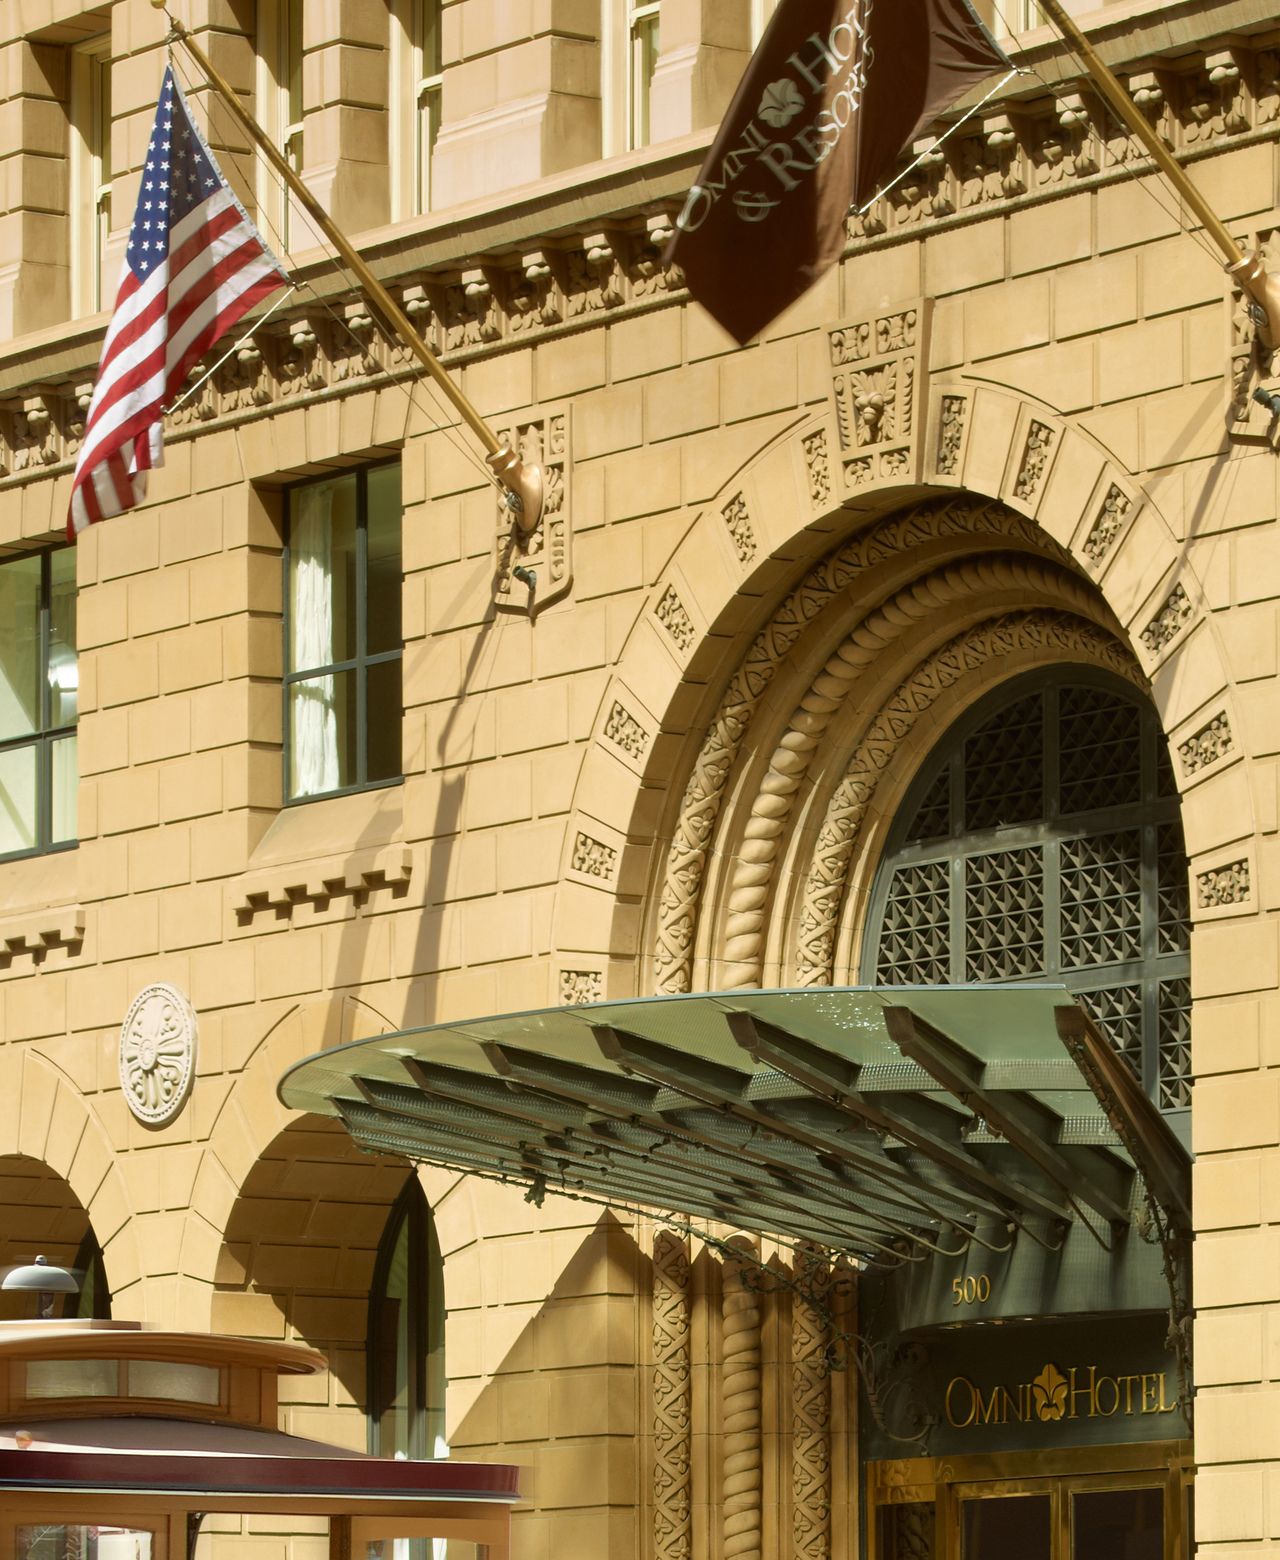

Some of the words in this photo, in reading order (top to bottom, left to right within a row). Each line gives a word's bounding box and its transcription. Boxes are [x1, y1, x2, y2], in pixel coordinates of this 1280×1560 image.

[677, 119, 770, 233] OMNI
[951, 1274, 991, 1306] 500
[945, 1376, 1033, 1429] OMNI
[1066, 1364, 1179, 1419] HOTEL
